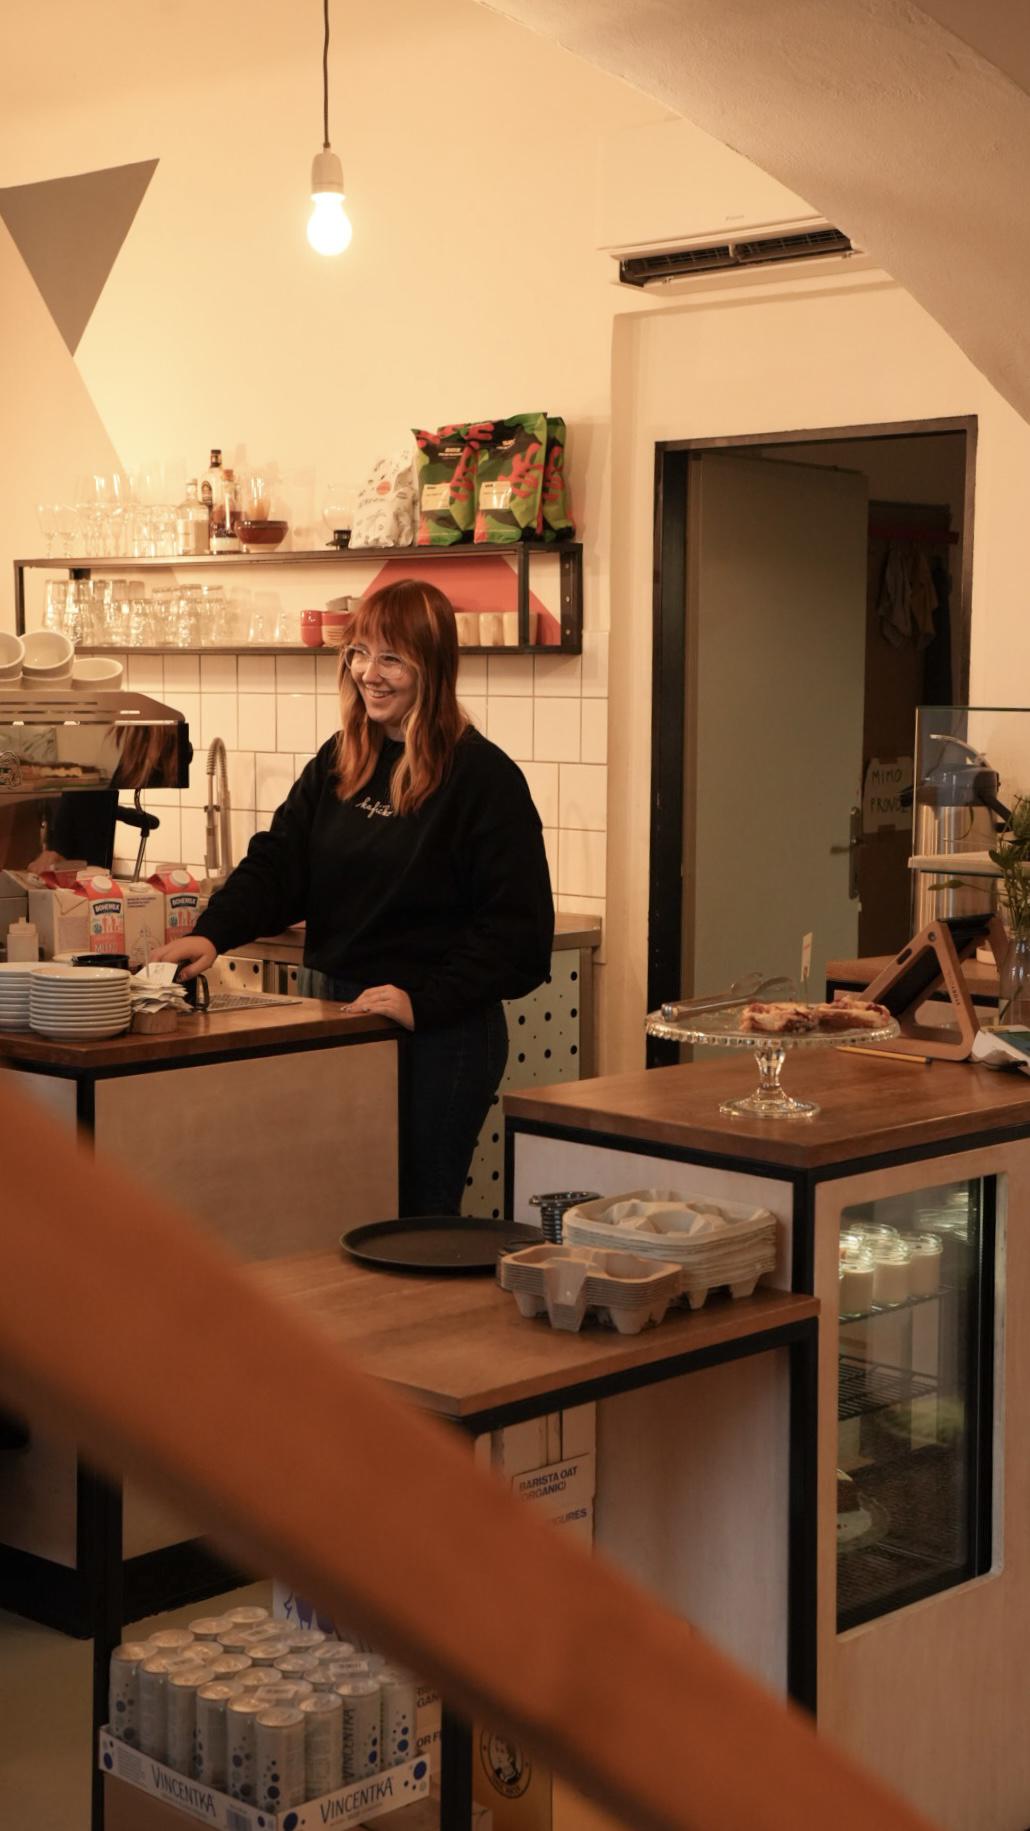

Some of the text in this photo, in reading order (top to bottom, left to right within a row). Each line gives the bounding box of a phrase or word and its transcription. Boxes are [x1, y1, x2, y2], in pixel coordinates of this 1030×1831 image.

[871, 768, 903, 784] MIMO
[870, 796, 908, 814] PROVO
[519, 1466, 577, 1491] BARISTA OAT
[151, 1764, 217, 1818] VINCENTKA
[320, 1776, 393, 1824] VINCENTKA
